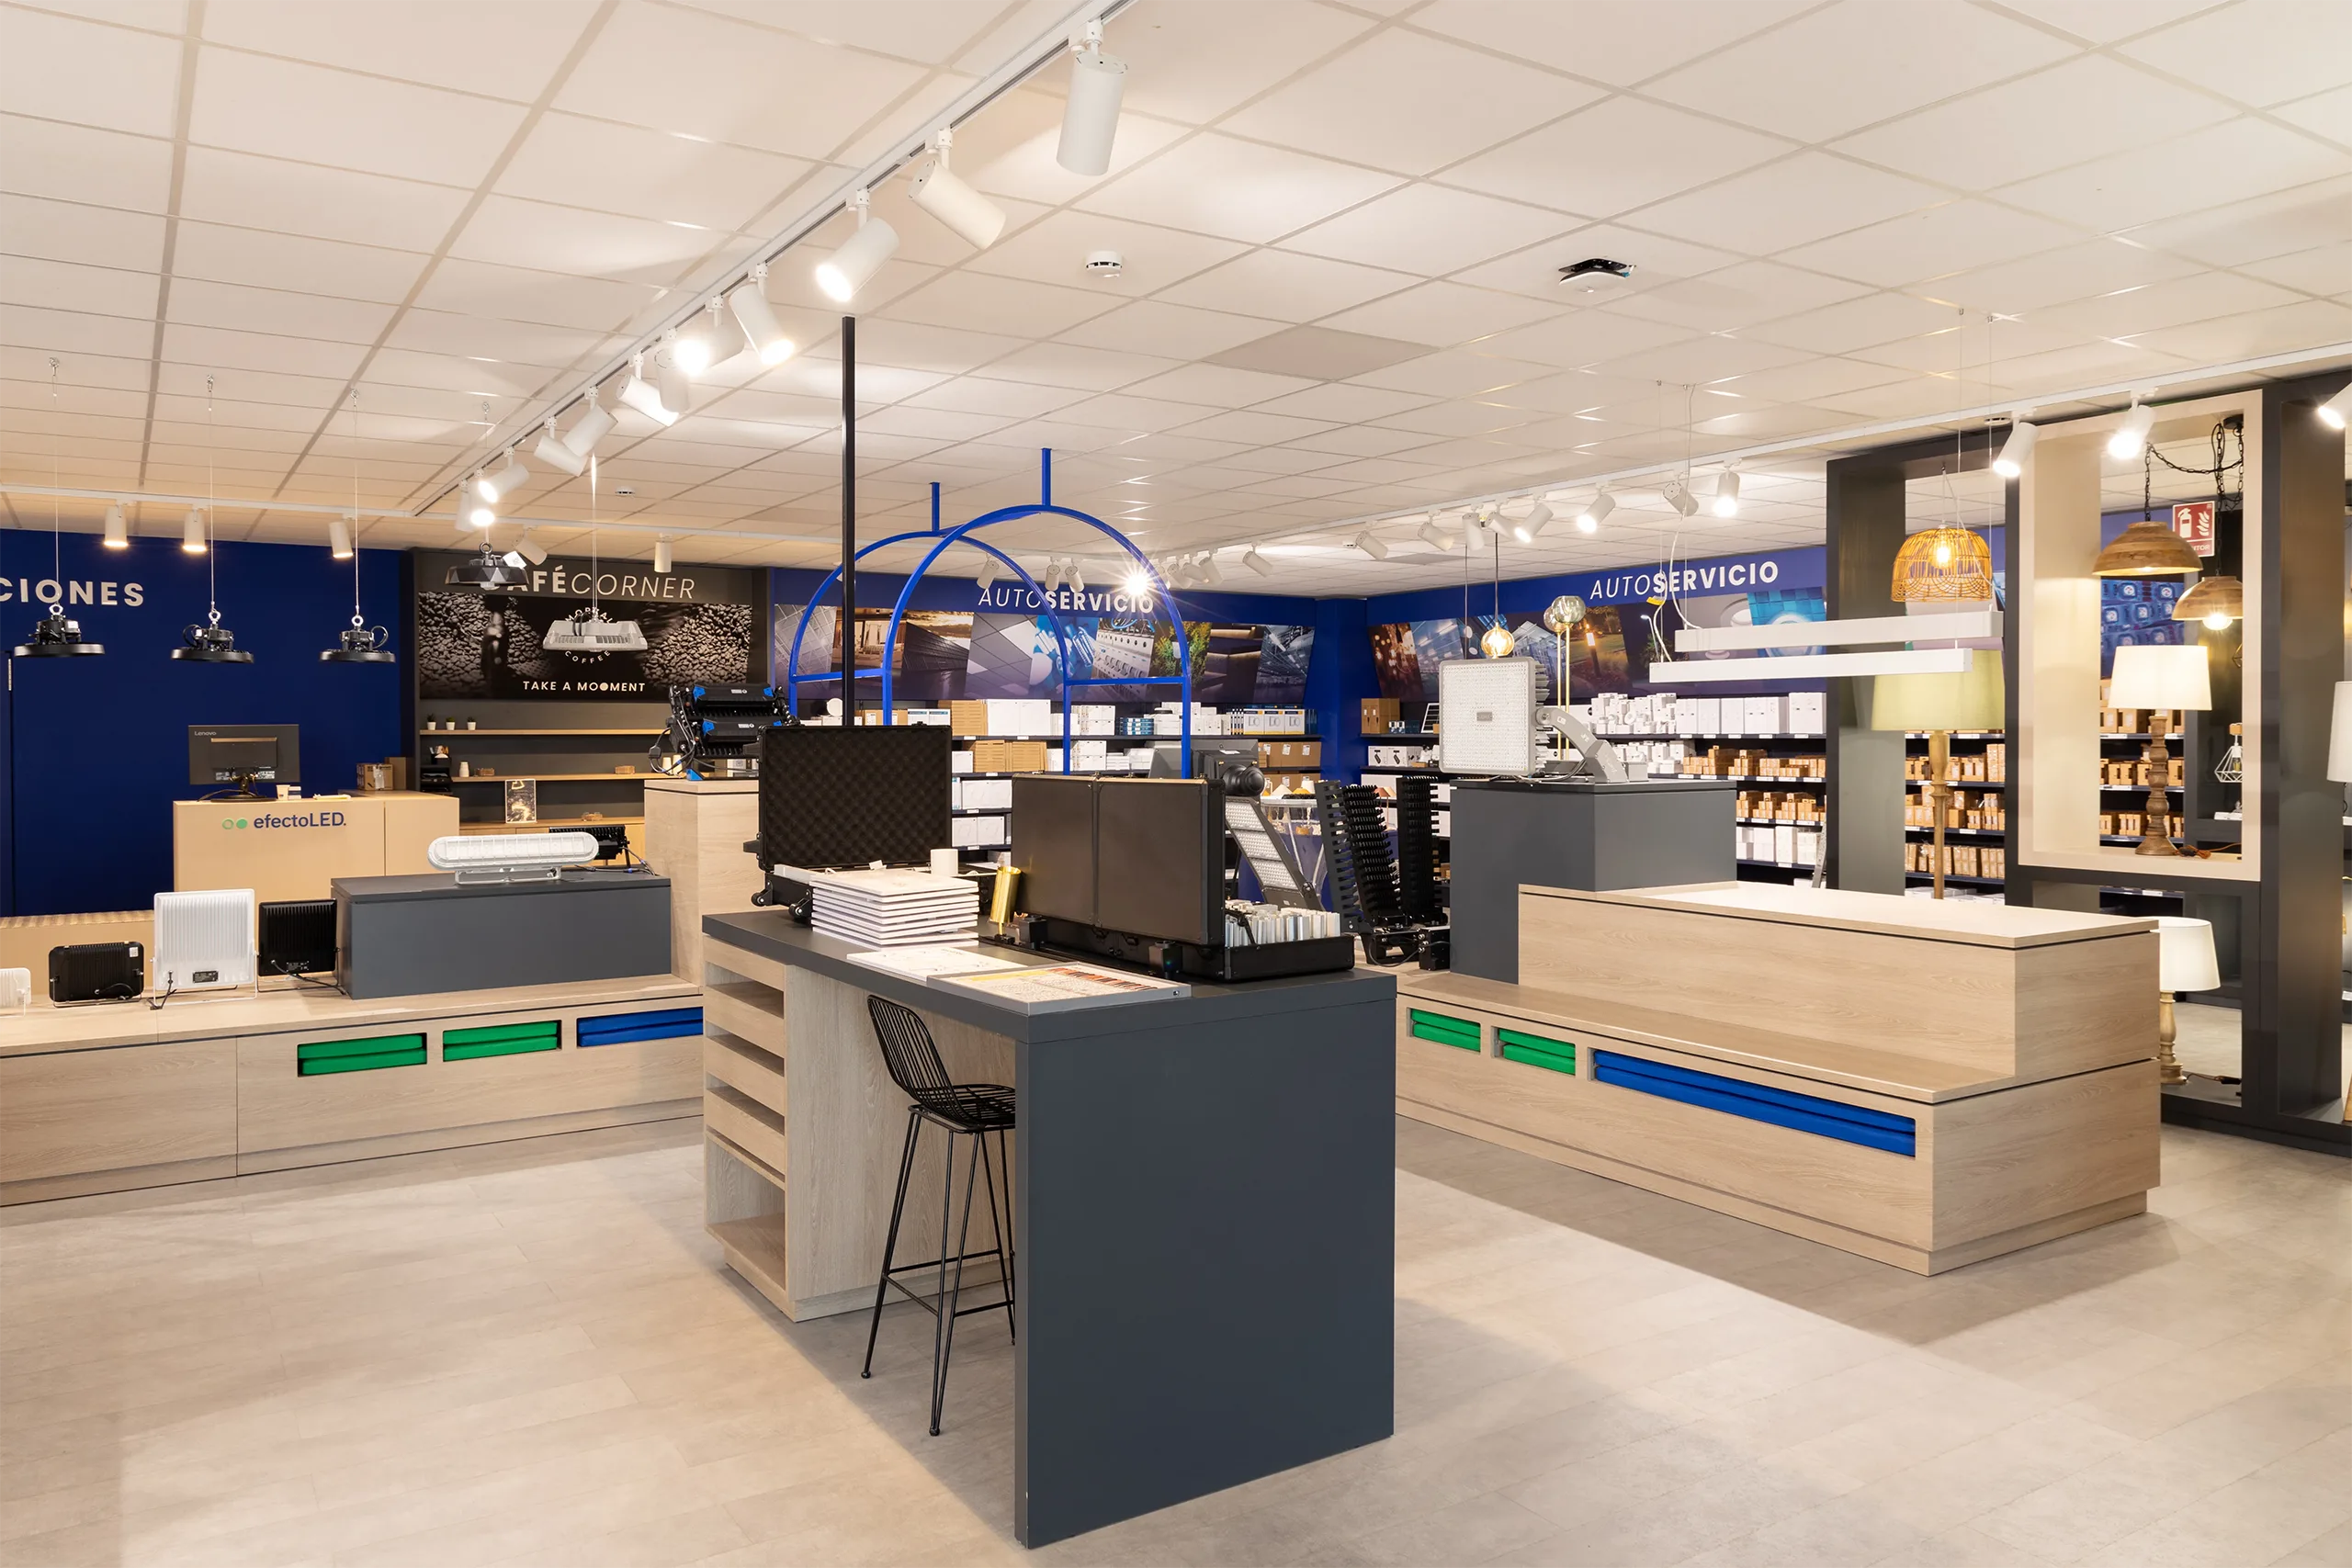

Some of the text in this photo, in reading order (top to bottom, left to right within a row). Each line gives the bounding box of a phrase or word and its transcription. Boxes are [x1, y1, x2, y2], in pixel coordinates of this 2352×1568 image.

[1589, 560, 1779, 600] AUTOSERVICIO
[564, 649, 611, 664] COFFEE
[523, 681, 557, 690] TAKE
[562, 682, 571, 691] A
